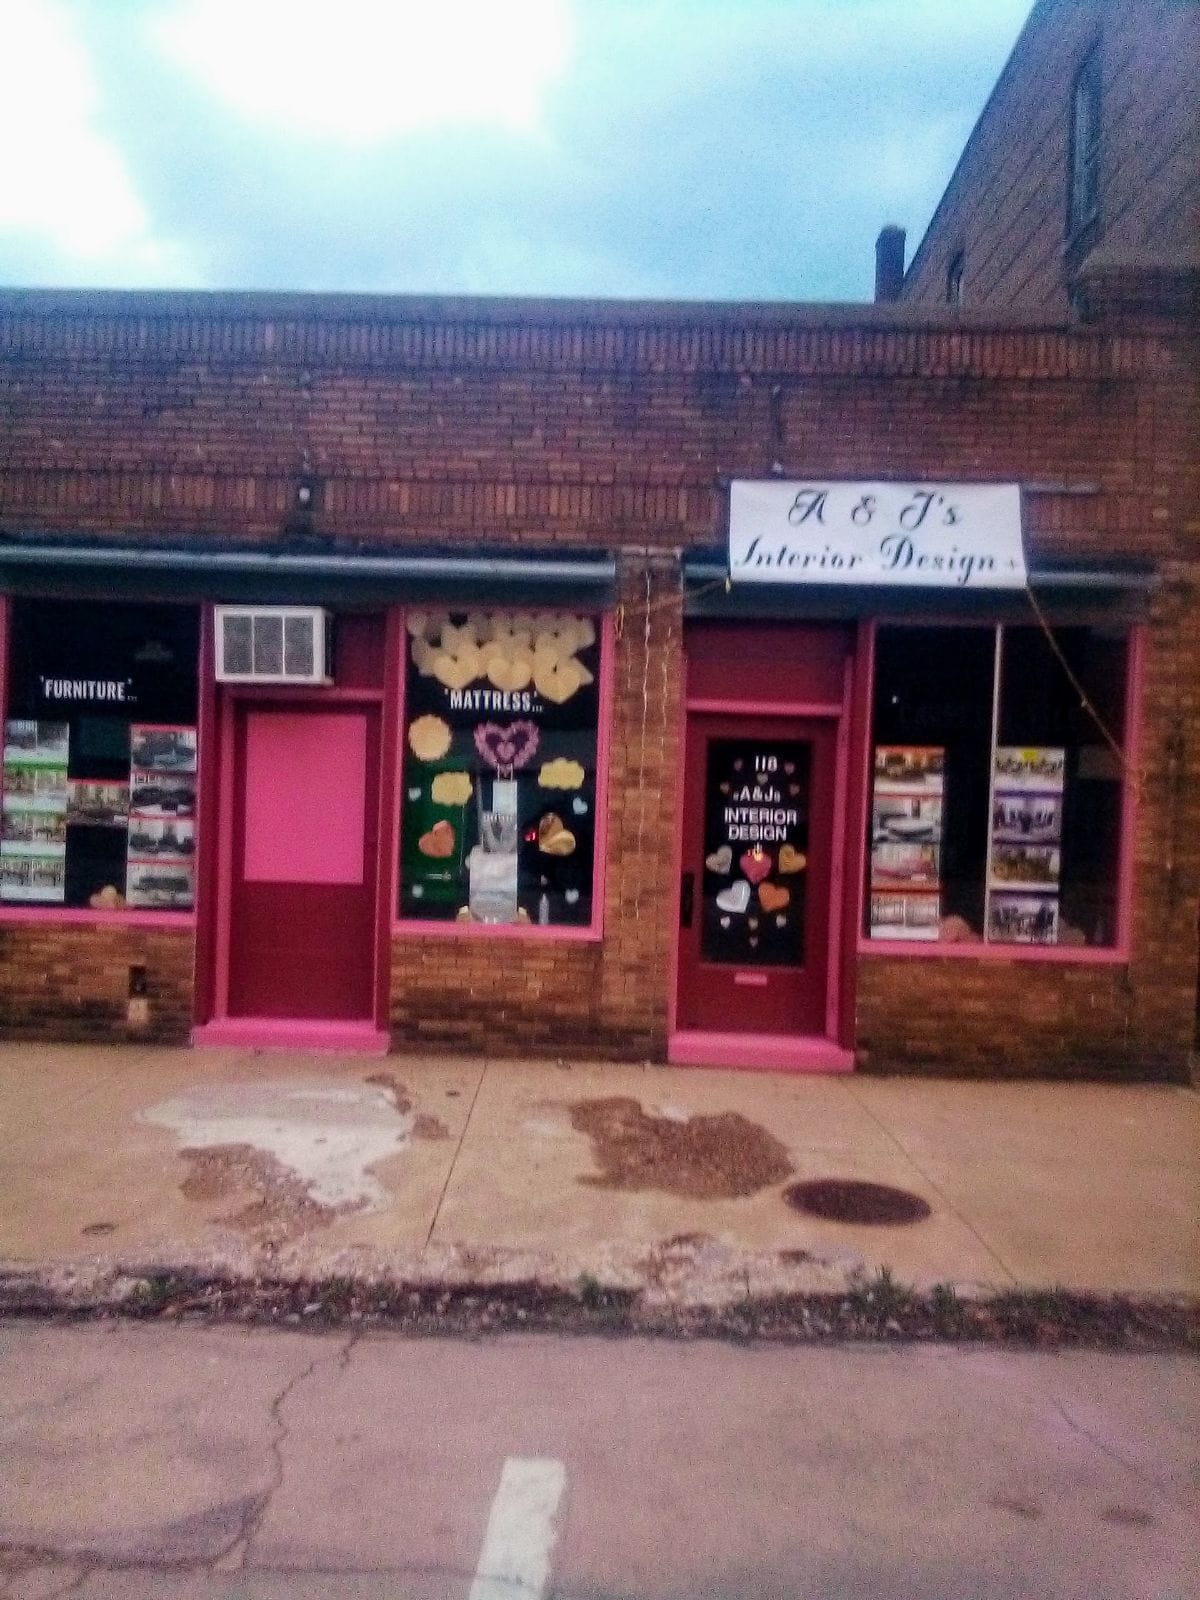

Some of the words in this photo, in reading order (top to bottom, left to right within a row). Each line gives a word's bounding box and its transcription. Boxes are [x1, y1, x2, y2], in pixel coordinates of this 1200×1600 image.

[788, 488, 828, 526] A
[851, 494, 877, 526] &
[900, 490, 961, 531] J's
[734, 534, 863, 569] Interior
[724, 807, 798, 826] INTERIOR
[728, 824, 787, 841] DESIGN
